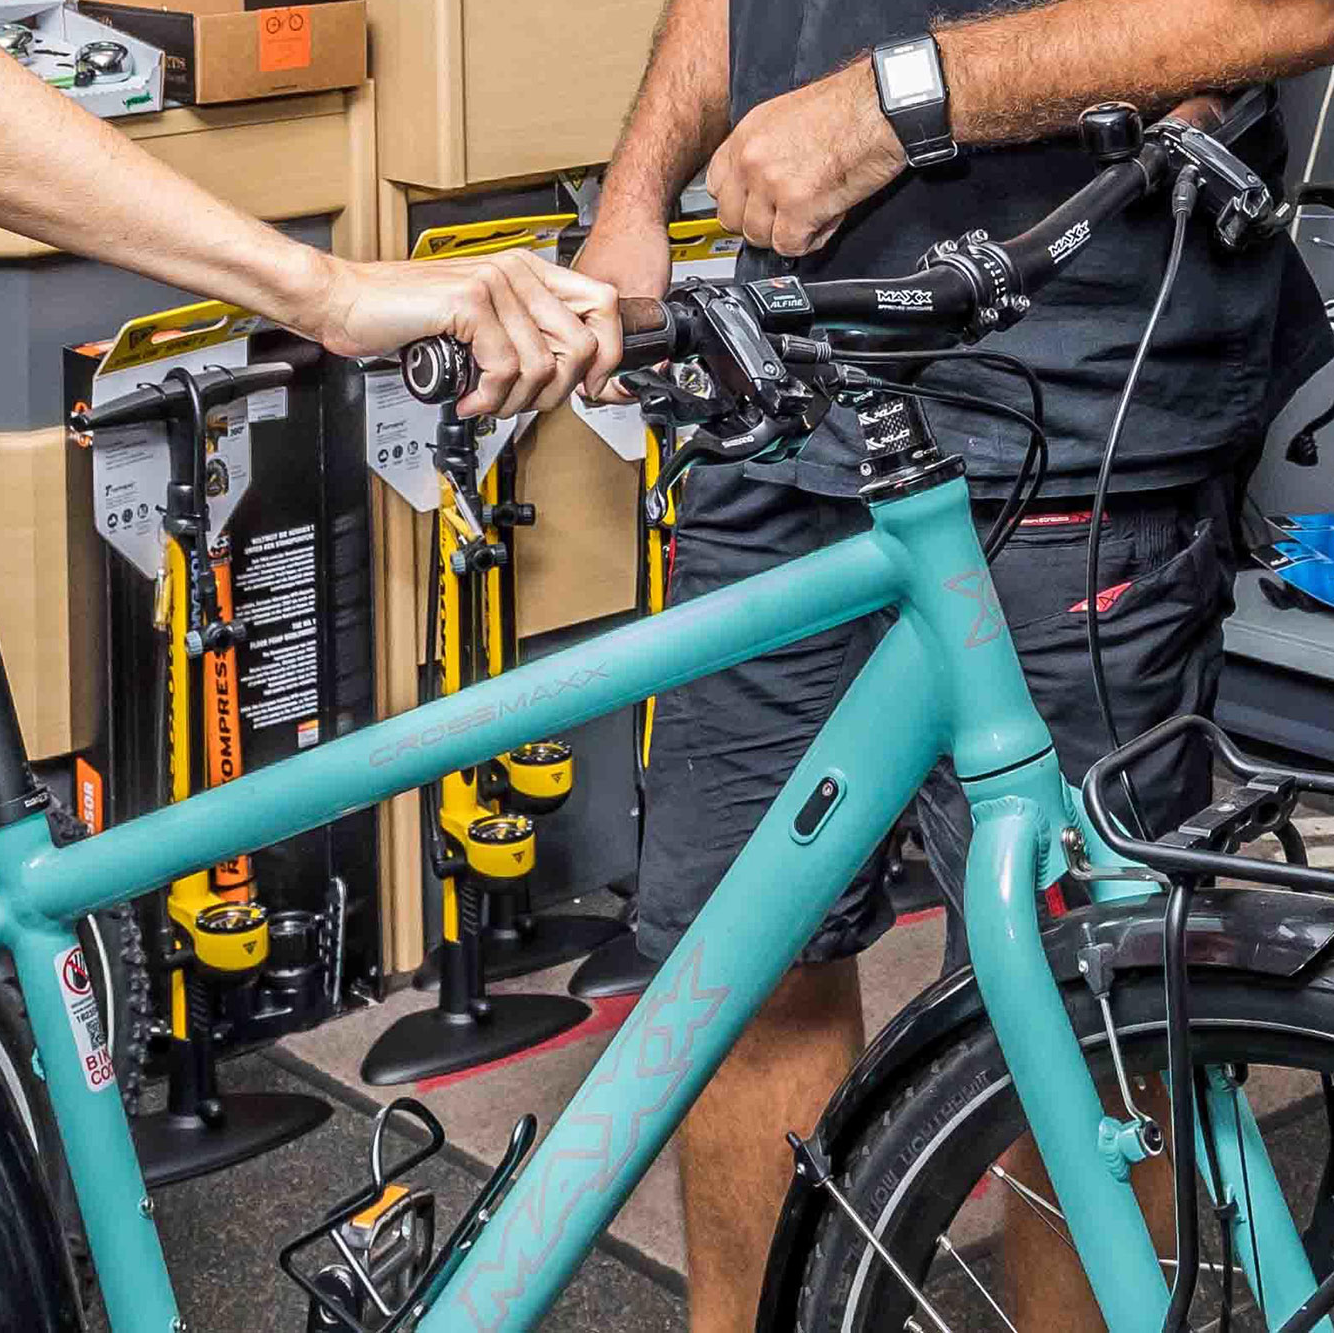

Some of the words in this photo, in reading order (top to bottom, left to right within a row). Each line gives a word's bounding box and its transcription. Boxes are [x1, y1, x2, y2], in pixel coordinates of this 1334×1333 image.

[770, 298, 803, 310] ALFINE
[875, 289, 932, 305] MAXX
[369, 663, 613, 767] CROSSMAXX
[85, 1045, 111, 1072] BIK
[457, 940, 731, 1333] MAXX
